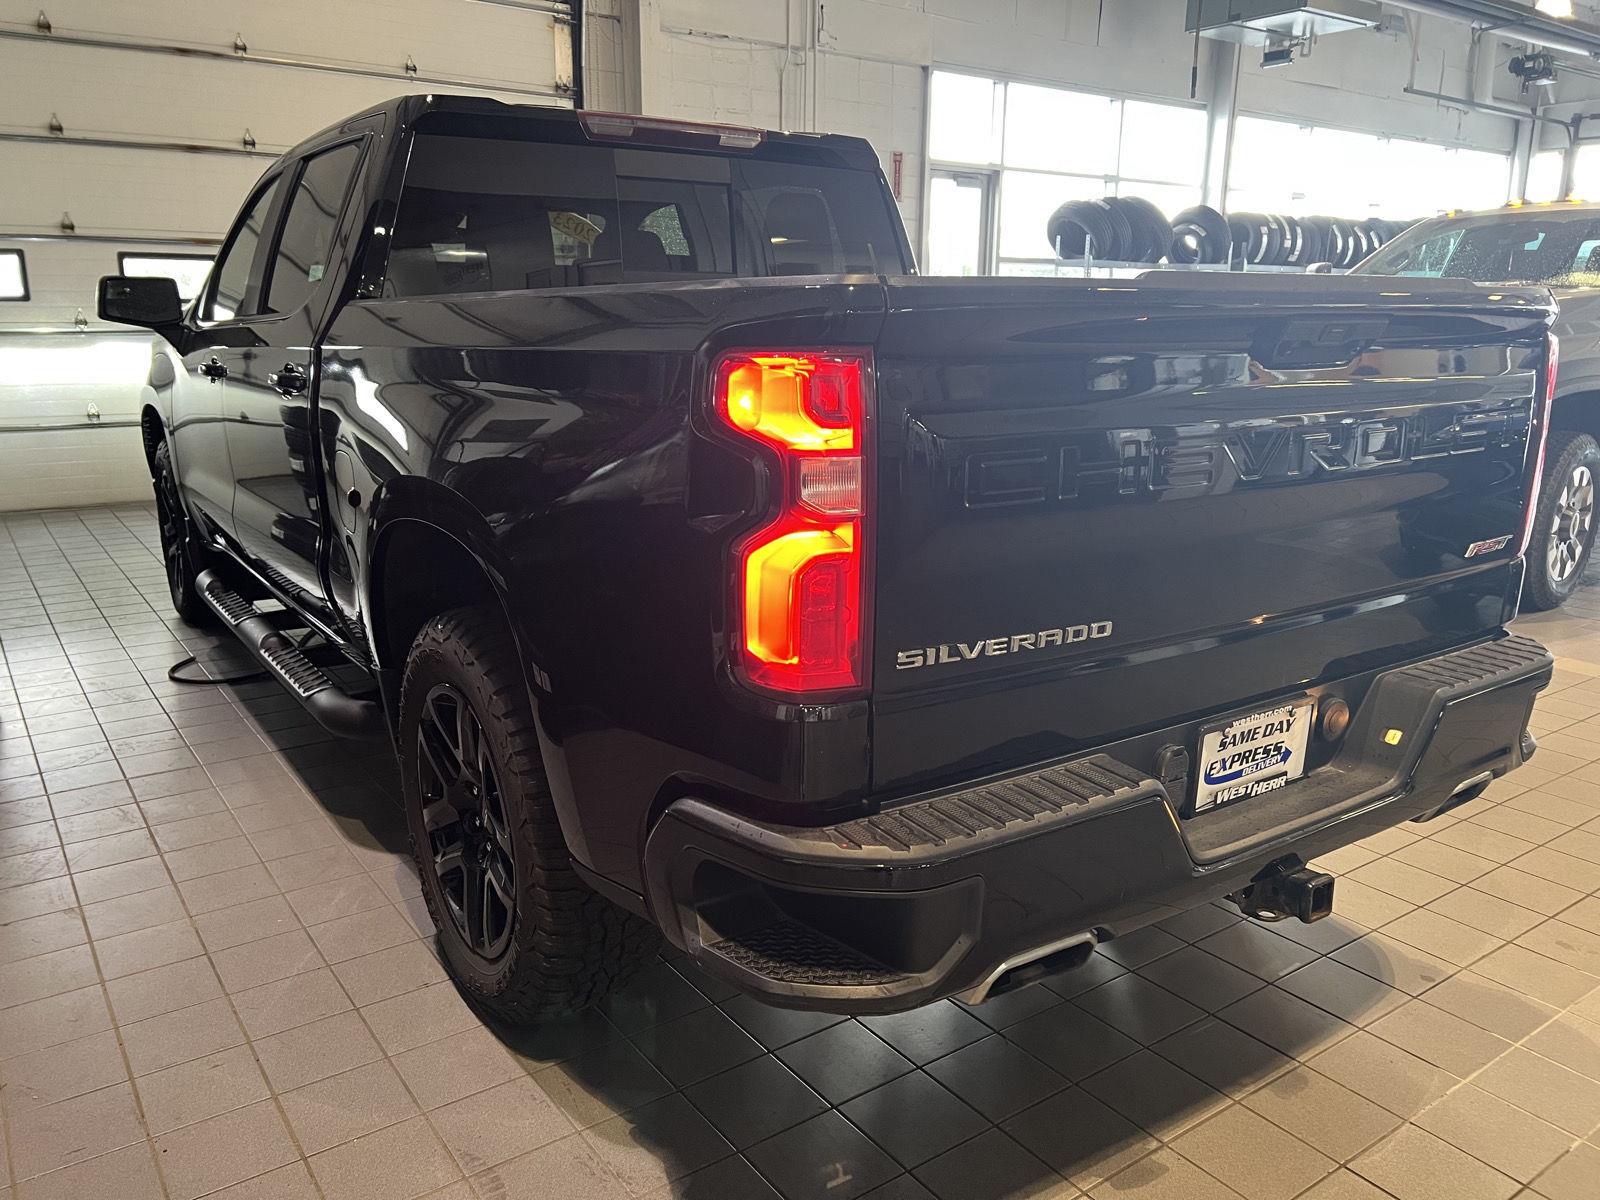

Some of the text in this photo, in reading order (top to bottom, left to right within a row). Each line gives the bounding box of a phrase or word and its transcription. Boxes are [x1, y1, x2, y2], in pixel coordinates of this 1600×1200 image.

[964, 403, 1527, 509] CHEVROLET
[1464, 534, 1514, 558] RST
[896, 620, 1113, 670] SILVERADO
[1232, 705, 1293, 727] westherr.com
[1217, 718, 1297, 752] SAME DAY
[1209, 740, 1285, 776] EXPRESS
[1242, 754, 1283, 775] DELIVERY
